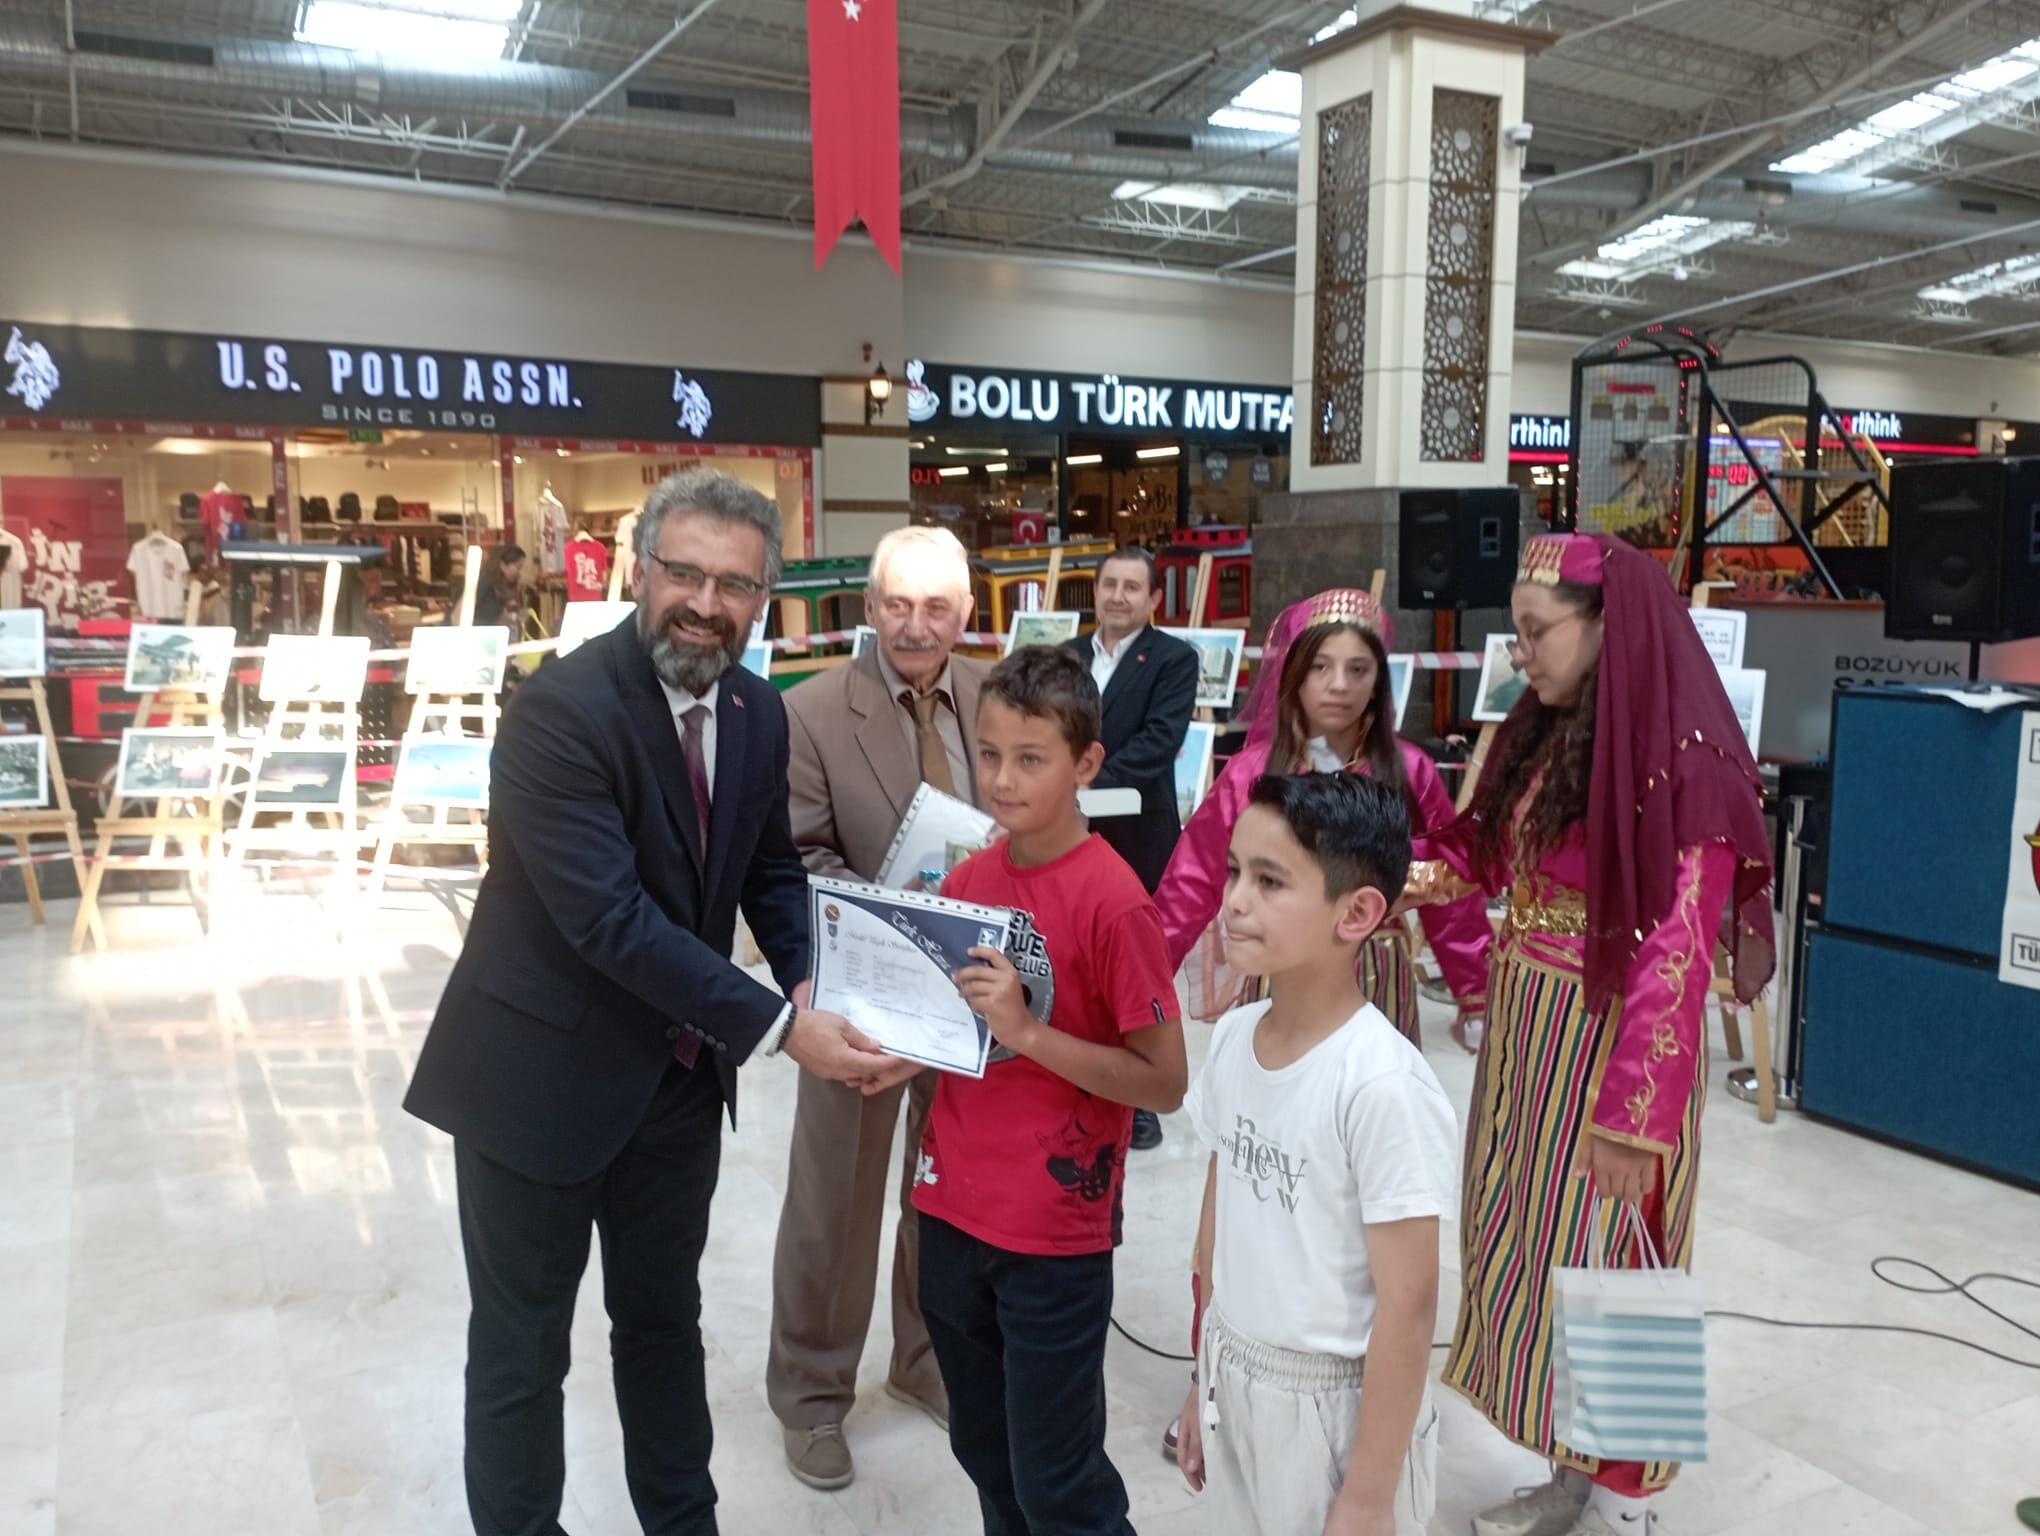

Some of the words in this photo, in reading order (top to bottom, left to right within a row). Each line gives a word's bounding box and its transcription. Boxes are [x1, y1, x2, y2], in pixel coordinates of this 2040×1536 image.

[216, 341, 302, 392] U.S.
[328, 348, 440, 400] POLO
[463, 357, 583, 408] ASSN.
[950, 374, 1060, 421] BOLU
[1072, 373, 1174, 427] TÜRK
[322, 403, 414, 425] SINCE
[427, 410, 497, 428] 1890
[1835, 654, 1961, 677] BOZÜYÜK
[2017, 940, 2040, 963] TÜ
